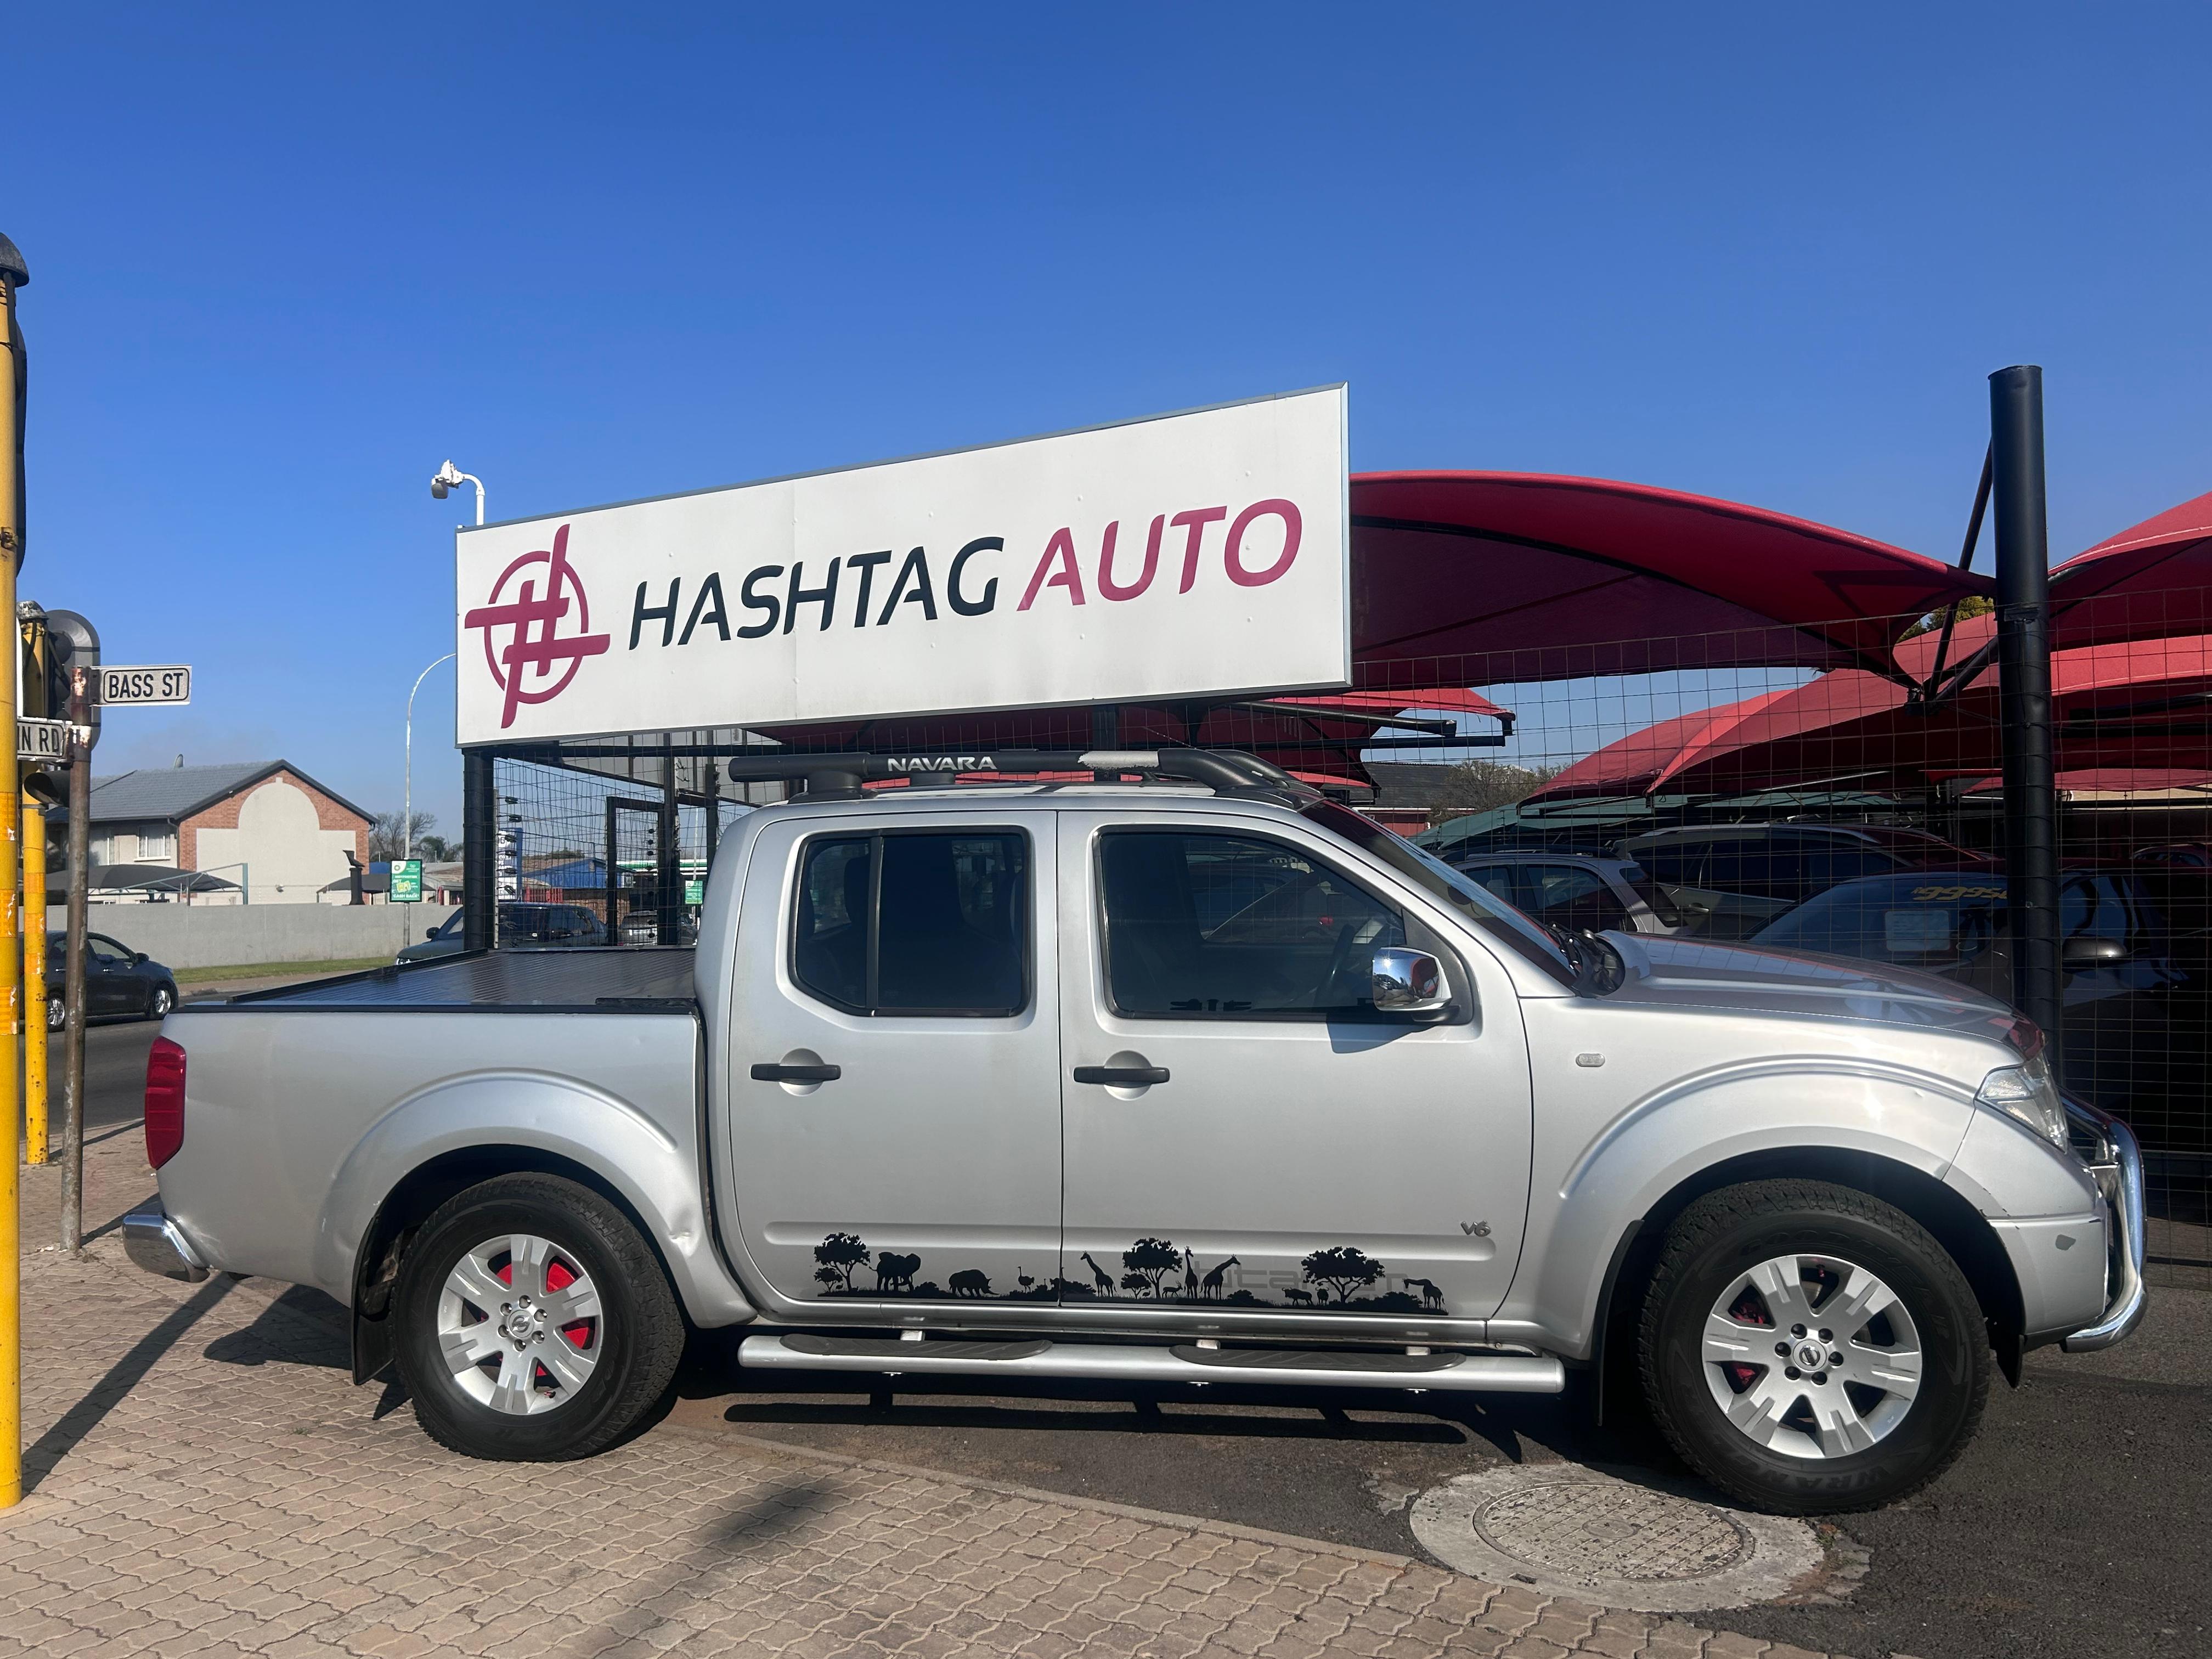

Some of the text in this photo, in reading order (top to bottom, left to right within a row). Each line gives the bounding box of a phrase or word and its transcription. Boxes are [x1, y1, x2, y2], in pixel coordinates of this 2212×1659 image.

[629, 499, 1302, 651] HASHTAG AUTO
[109, 672, 183, 698] BASS ST
[39, 727, 59, 752] RD
[888, 756, 997, 771] NAVARA
[1460, 1220, 1491, 1237] V6
